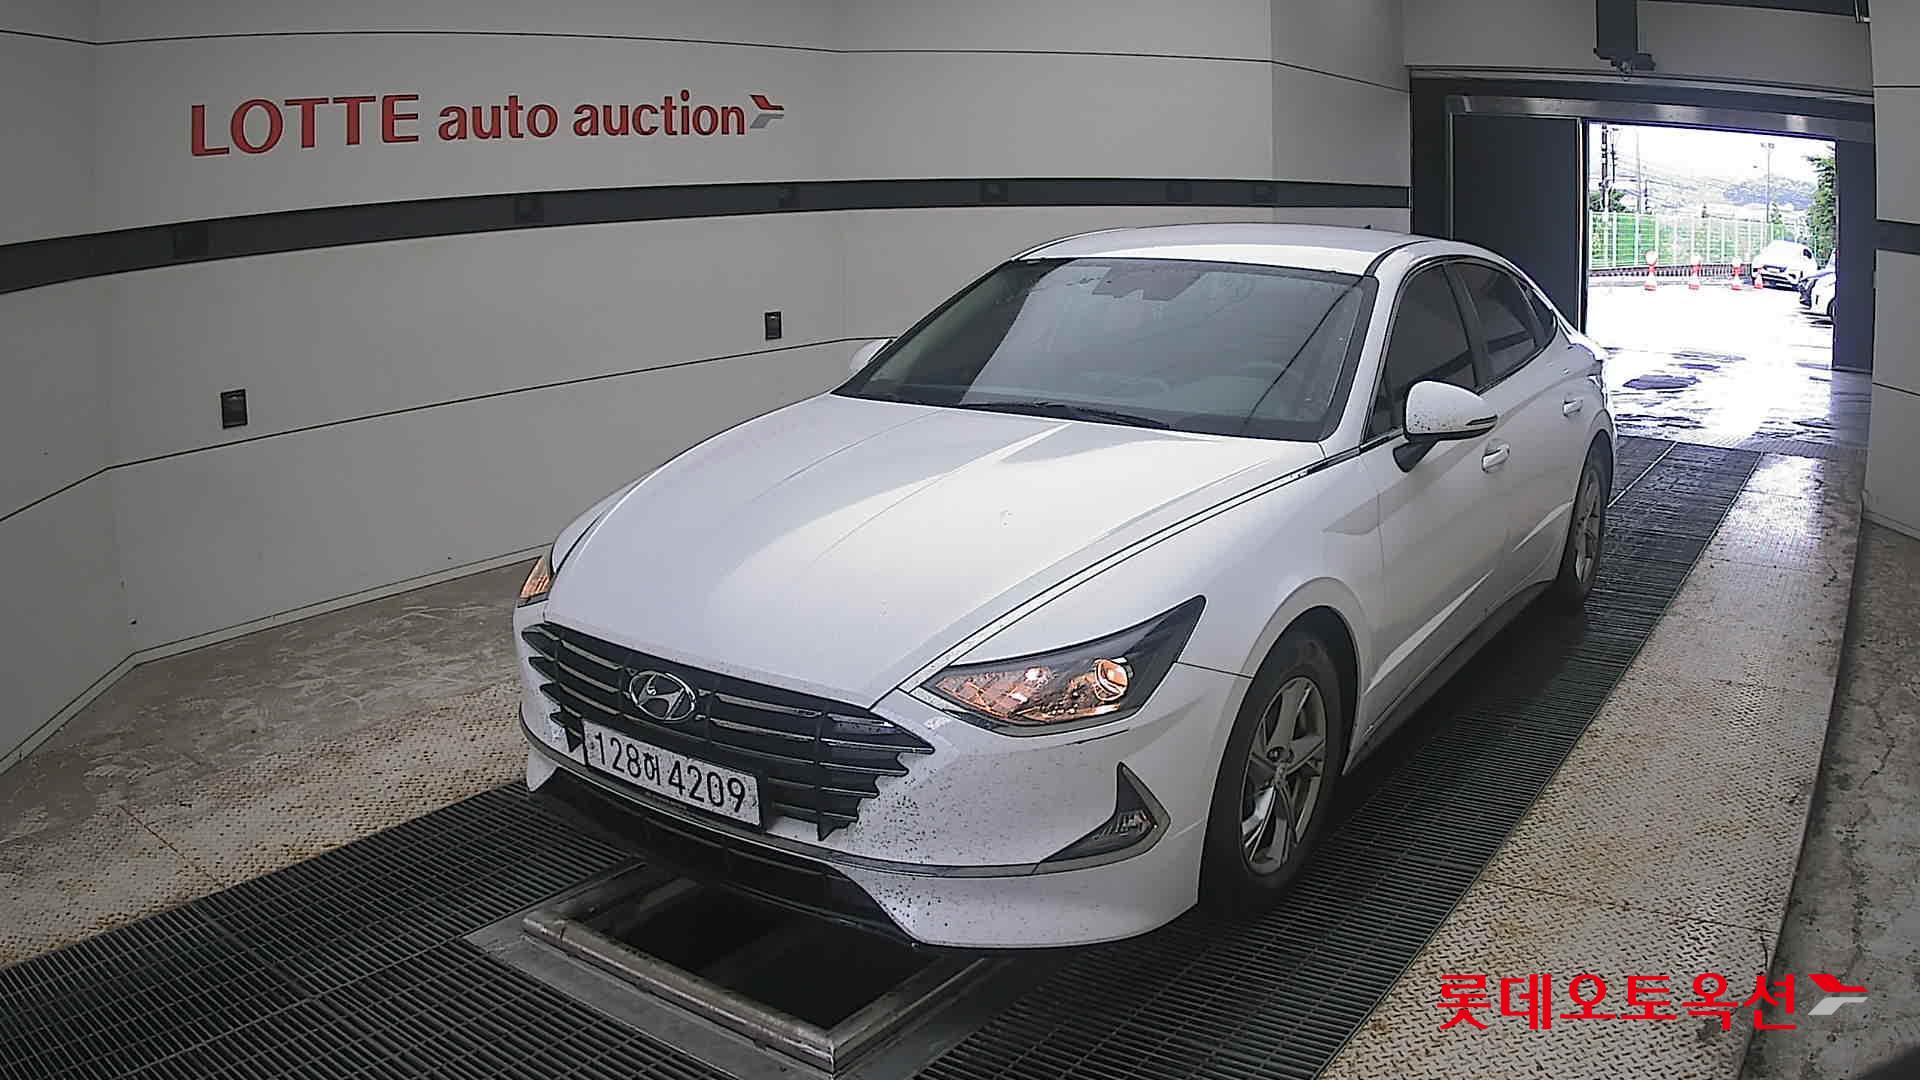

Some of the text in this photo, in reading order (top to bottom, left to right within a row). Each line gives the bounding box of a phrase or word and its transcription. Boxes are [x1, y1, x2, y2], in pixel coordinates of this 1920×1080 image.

[191, 89, 747, 155] LOTTE auto auction
